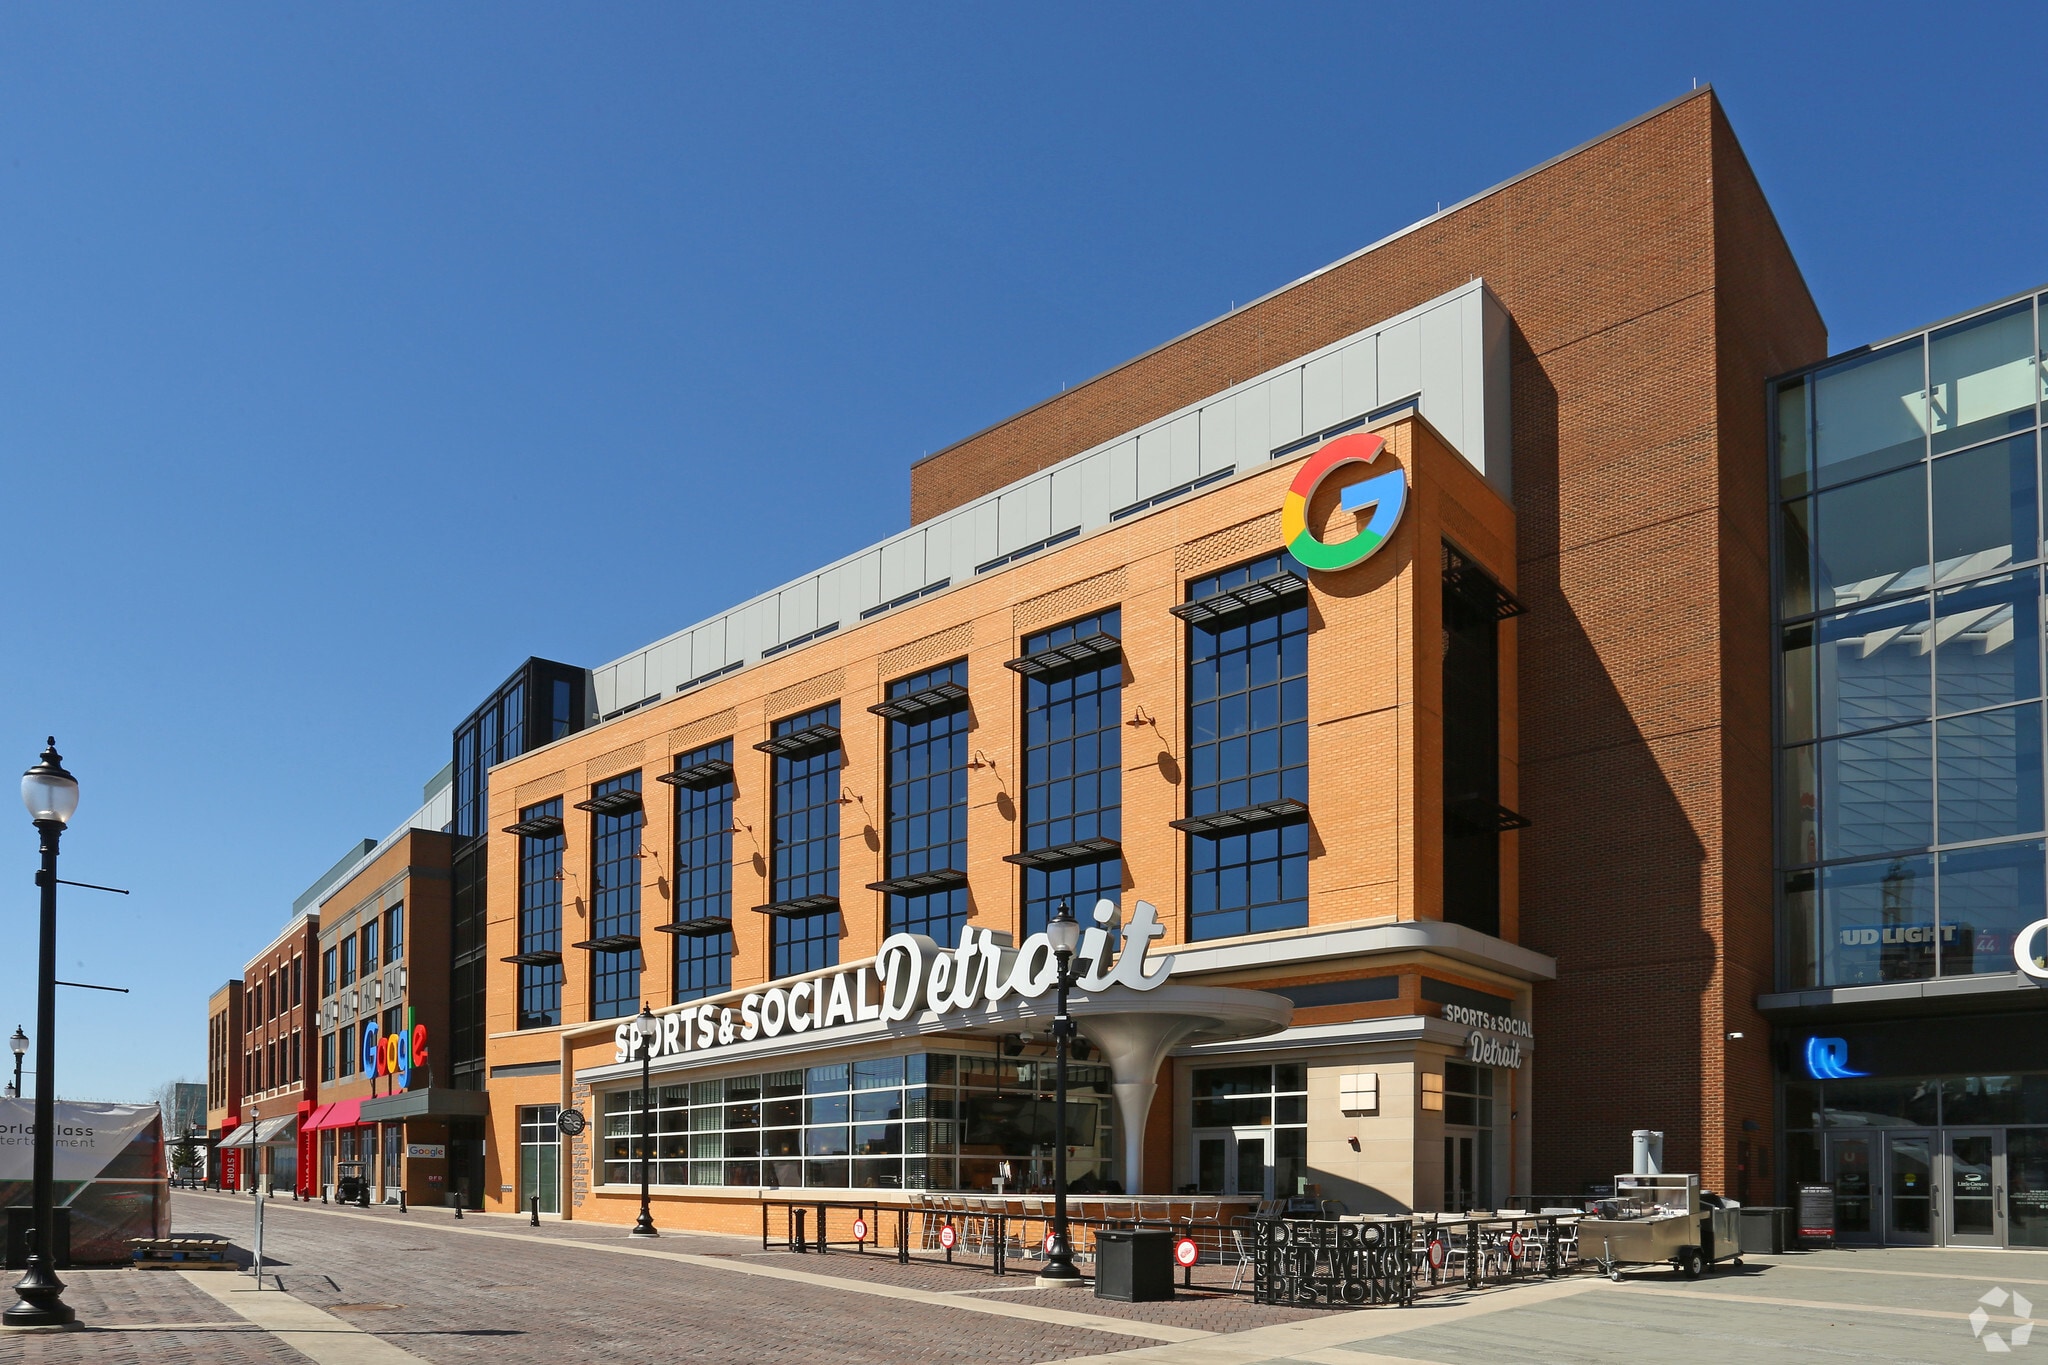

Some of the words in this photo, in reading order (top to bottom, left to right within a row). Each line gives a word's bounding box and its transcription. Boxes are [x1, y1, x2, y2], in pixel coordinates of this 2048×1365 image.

[1282, 433, 1407, 572] G
[1882, 925, 1957, 944] LIGHT
[614, 1004, 719, 1064] SPORTS
[718, 1008, 737, 1046] &
[740, 967, 880, 1042] SOCIAL
[875, 898, 1176, 1023] Detroit
[1446, 1003, 1490, 1030] SPORTS
[1497, 1015, 1534, 1039] SOCIAL
[363, 1006, 428, 1089] Google
[1470, 1030, 1522, 1070] Detroit
[0, 1124, 35, 1135] orld
[53, 1125, 94, 1136] lass
[410, 1145, 444, 1157] Google
[1271, 1222, 1403, 1248] DETROIT
[1271, 1247, 1316, 1277] RED
[1329, 1247, 1402, 1278] WINGS
[1271, 1277, 1401, 1304] PISTONS
